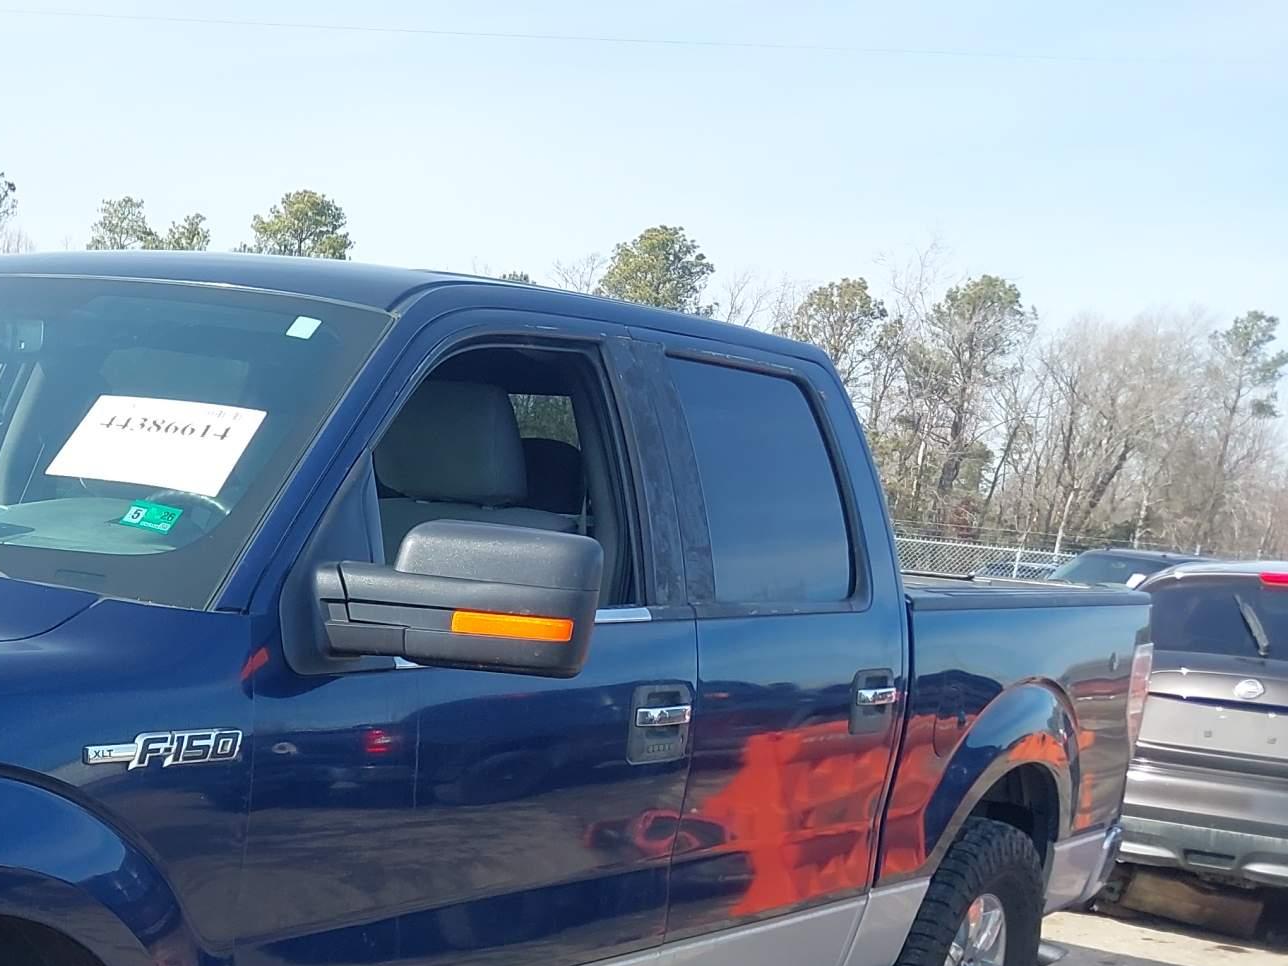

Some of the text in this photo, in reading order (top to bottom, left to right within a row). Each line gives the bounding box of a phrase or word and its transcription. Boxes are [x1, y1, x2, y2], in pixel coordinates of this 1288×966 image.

[99, 415, 232, 441] 44386614
[130, 508, 144, 520] 5
[159, 511, 177, 522] 26
[93, 728, 243, 770] XLT F-150
